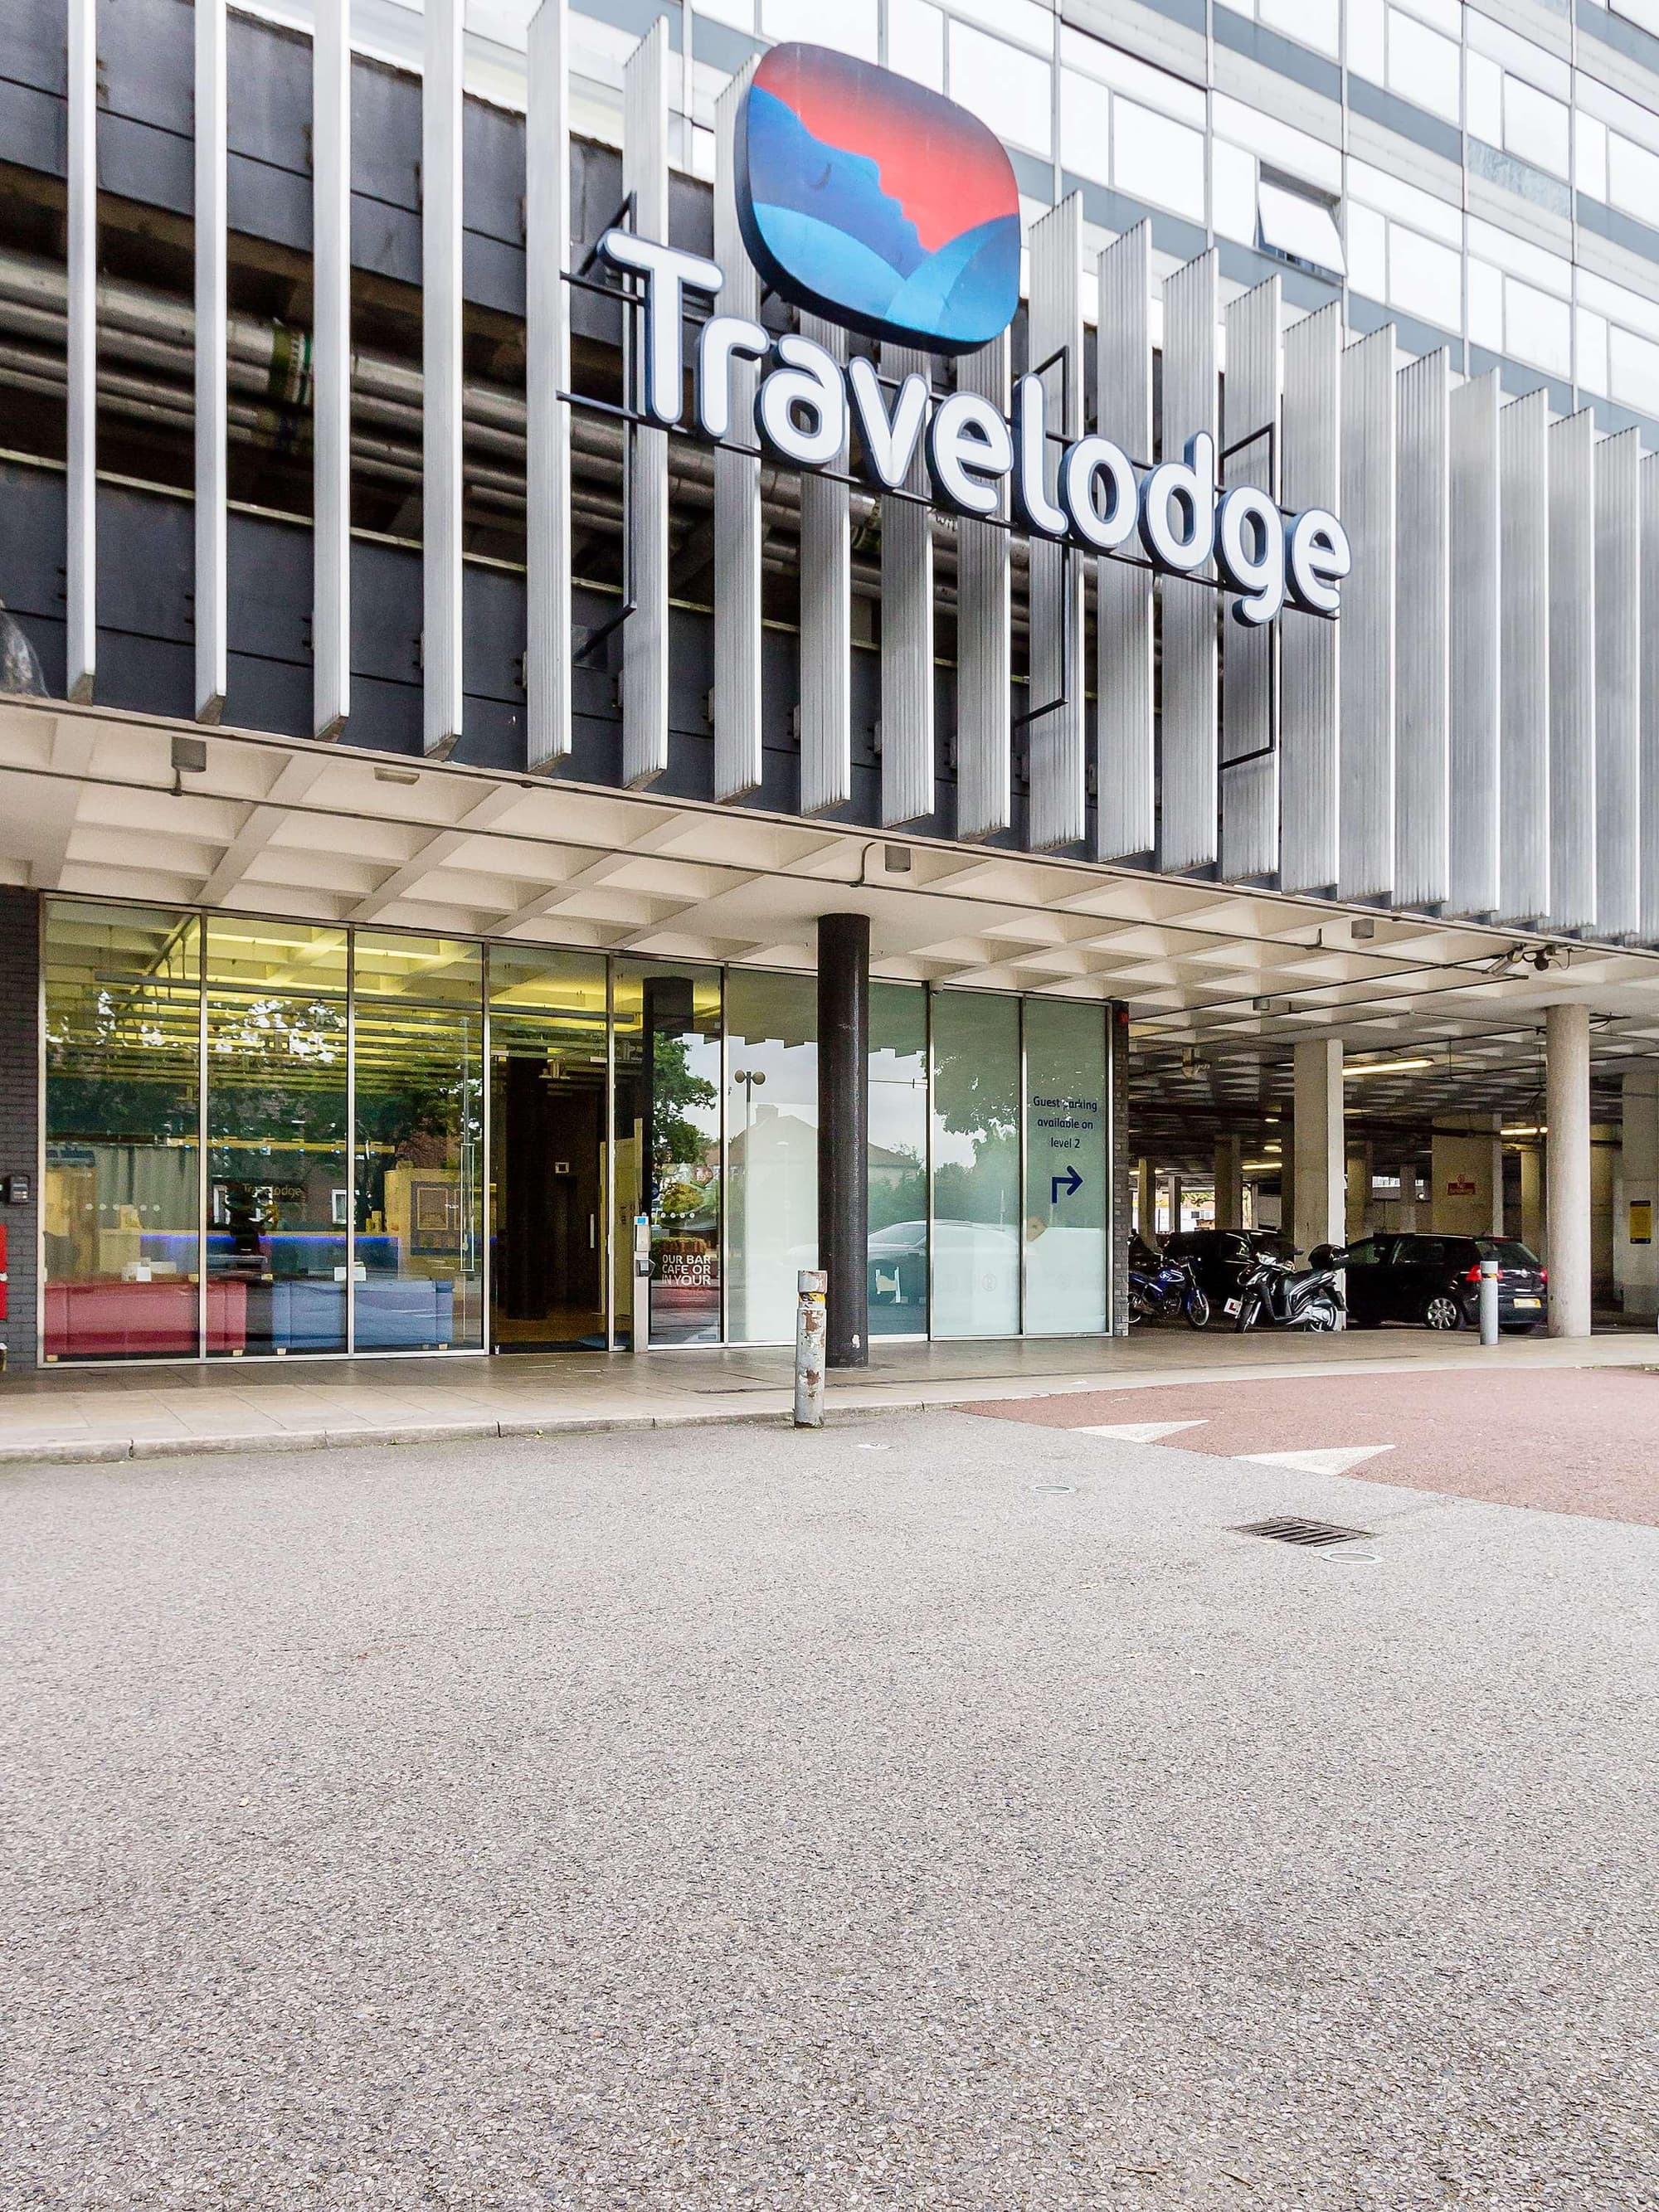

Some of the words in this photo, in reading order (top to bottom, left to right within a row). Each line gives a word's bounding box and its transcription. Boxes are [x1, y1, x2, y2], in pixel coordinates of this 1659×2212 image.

[597, 228, 1351, 627] Travelodge
[1033, 1096, 1061, 1108] Guest
[1063, 1099, 1097, 1112] parking
[1038, 1118, 1079, 1129] available
[1050, 1137, 1072, 1149] level
[1074, 1139, 1081, 1149] 2
[662, 1254, 684, 1265] OUR
[686, 1254, 712, 1265] BAR
[662, 1264, 689, 1275] CAFE
[692, 1264, 712, 1275] OR
[662, 1274, 672, 1286] IN
[674, 1274, 712, 1286] YOUR
[1228, 1302, 1236, 1311] L
